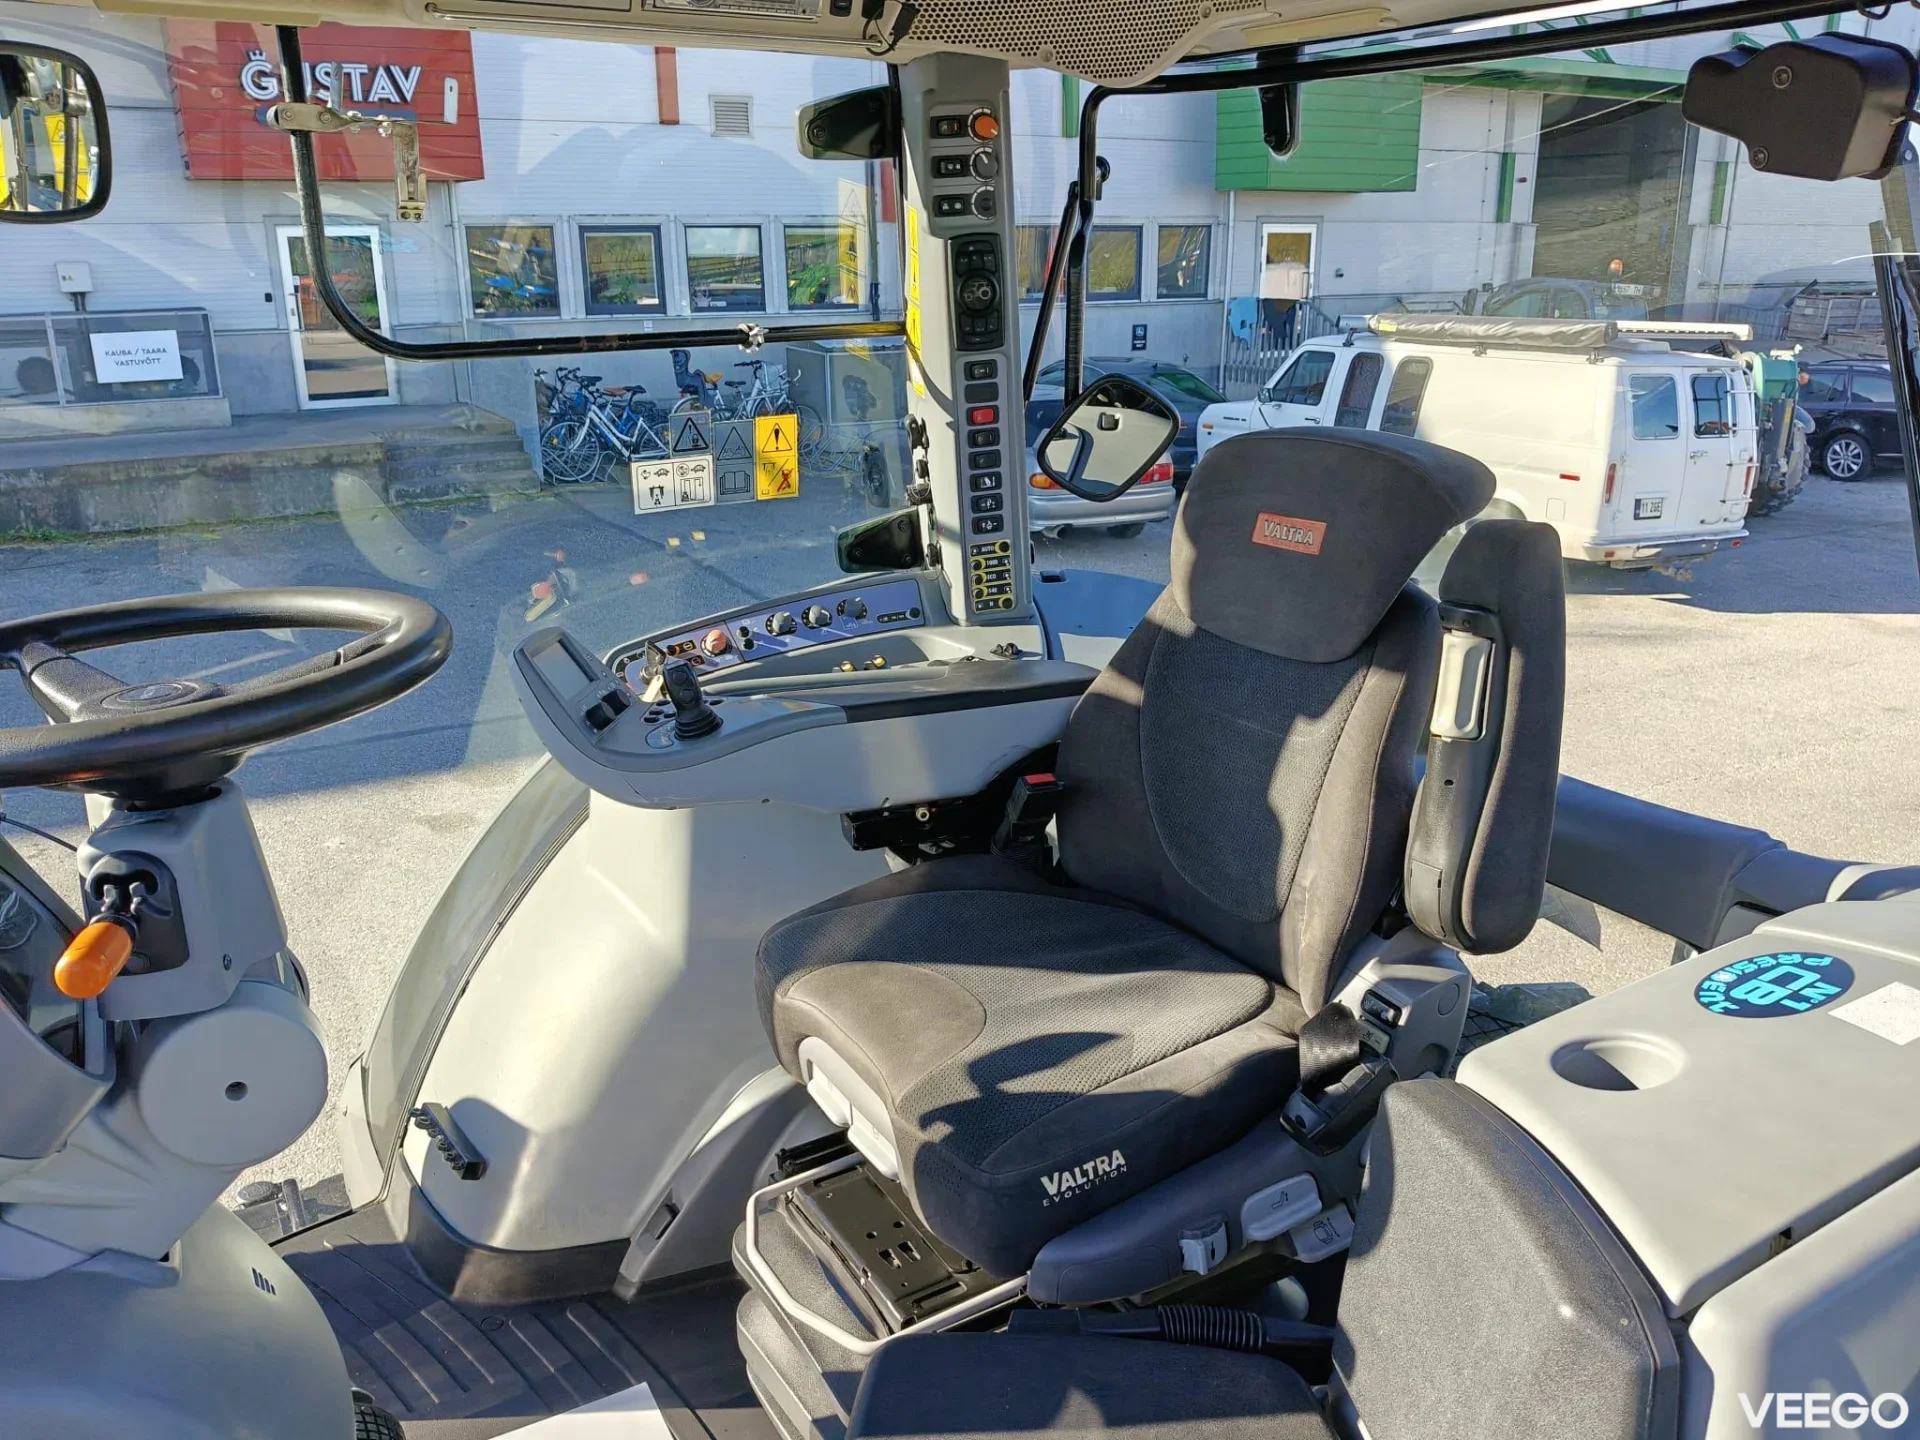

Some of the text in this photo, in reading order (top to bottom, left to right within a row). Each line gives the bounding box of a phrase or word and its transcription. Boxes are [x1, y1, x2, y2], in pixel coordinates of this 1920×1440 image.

[105, 349, 132, 357] KAUBA
[140, 347, 168, 355] TAARA
[1264, 520, 1314, 545] VALTRA
[1698, 953, 1834, 1013] PRESIDENT
[1040, 1149, 1126, 1196] VALTRA
[1042, 1165, 1128, 1207] EVOLUTION
